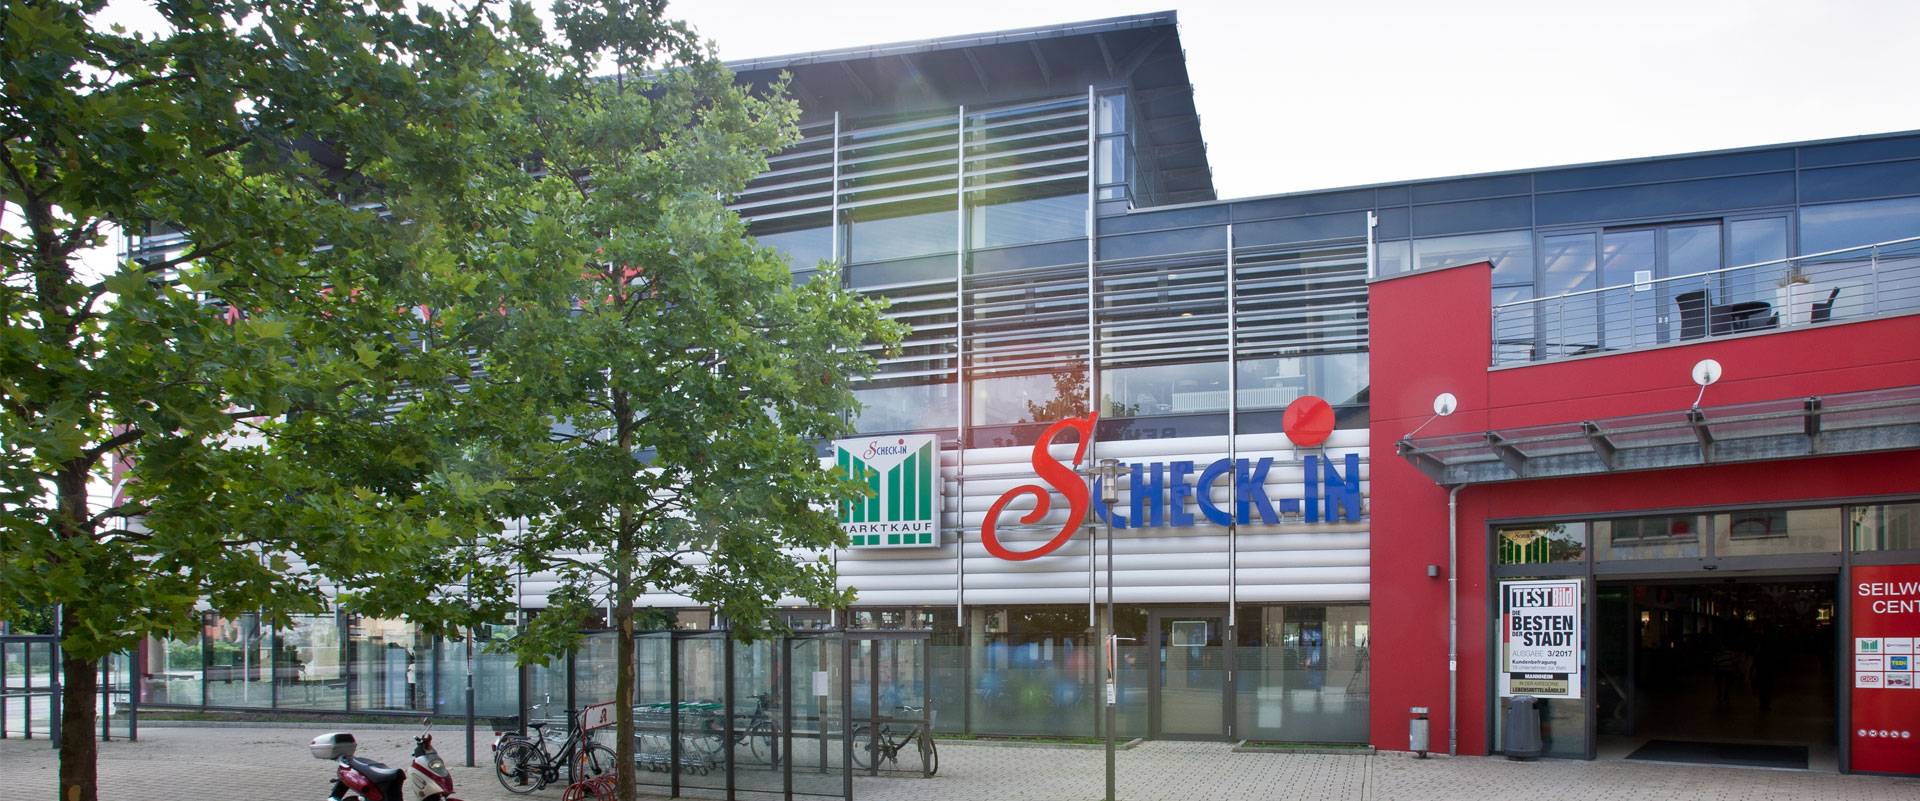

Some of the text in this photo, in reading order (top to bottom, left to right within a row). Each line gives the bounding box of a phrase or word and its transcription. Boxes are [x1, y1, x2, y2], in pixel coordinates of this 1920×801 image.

[1858, 582, 1920, 597] SEILW
[1512, 588, 1552, 607] TEST
[1512, 616, 1573, 630] BESTEN
[1523, 632, 1573, 646] STADT
